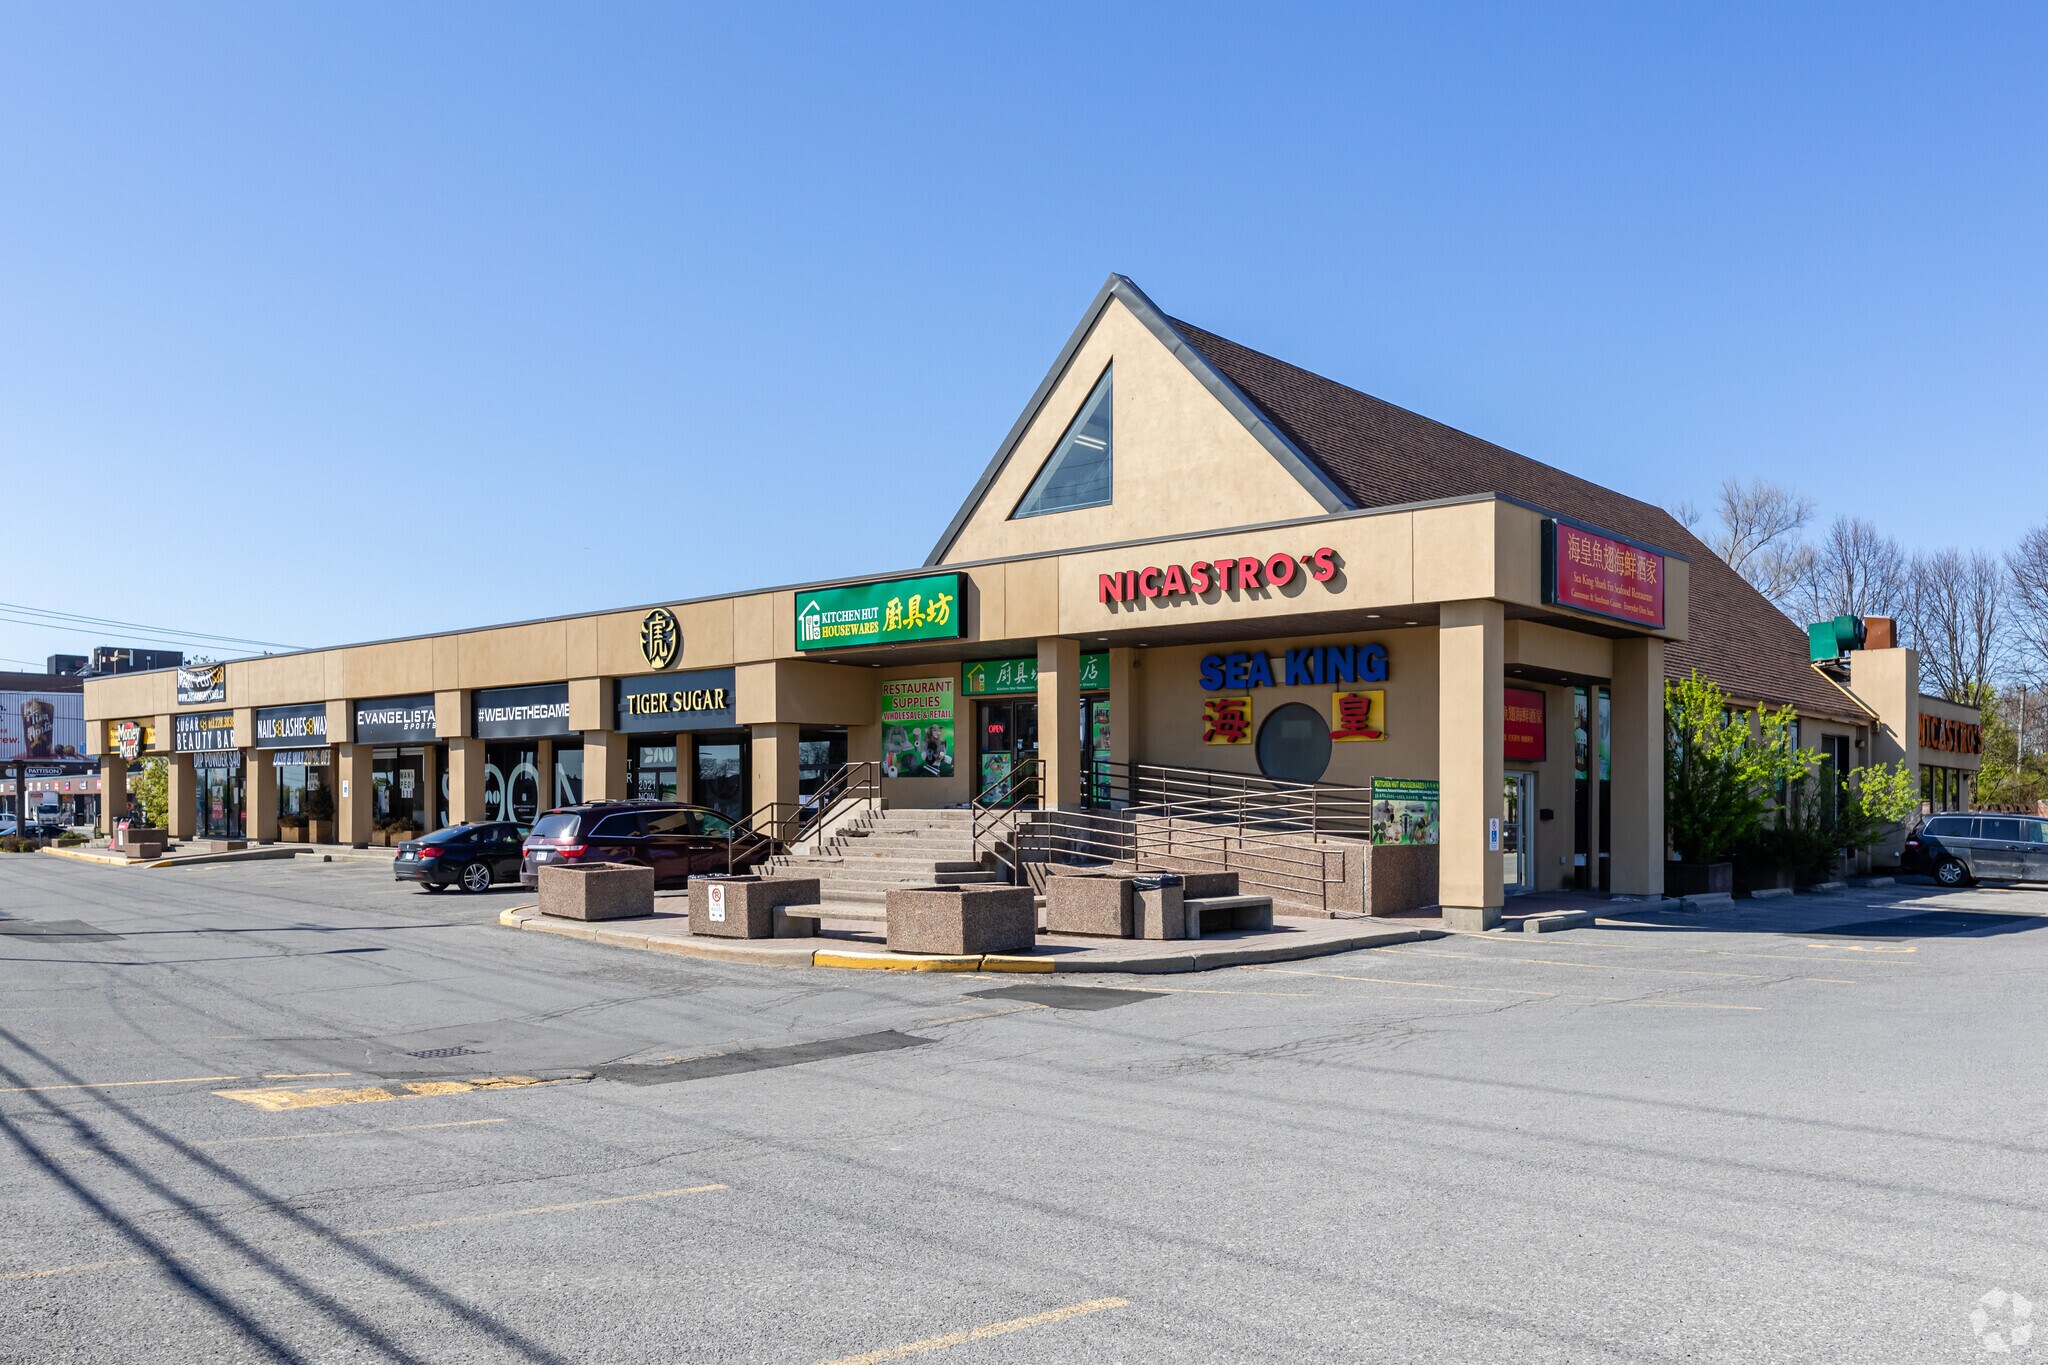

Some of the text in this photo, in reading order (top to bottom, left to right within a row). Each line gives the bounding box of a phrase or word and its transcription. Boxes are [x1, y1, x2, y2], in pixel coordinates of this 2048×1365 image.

[1568, 533, 1657, 585] 海皇魚翅海鮮酒家
[1573, 571, 1581, 584] Sea
[1582, 573, 1594, 590] King
[1594, 577, 1607, 590] Shark
[822, 606, 879, 624] KITCHEN HUT
[822, 621, 879, 638] HOUSEWARES
[1200, 643, 1390, 691] SEA KING
[883, 680, 952, 695] RESTAURANT
[626, 687, 727, 715] TIGER SUGAR
[893, 696, 940, 709] SUPPLIES
[357, 709, 436, 725] EVANGELISTA
[478, 703, 569, 722] #WELIVETHEGAME
[883, 710, 952, 721] WHOLESALE & RETAIL
[1202, 699, 1250, 743] 海
[1330, 693, 1383, 740] 皇
[177, 716, 199, 732] SUGAR
[257, 719, 276, 739] NAILS
[281, 717, 307, 738] LASHES
[404, 721, 437, 730] SPORTS
[988, 724, 1004, 733] OPEN
[117, 724, 141, 746] Money
[177, 729, 235, 751] BEAUTY BAR
[119, 741, 139, 759] Mart
[273, 752, 287, 765] LASH
[292, 751, 304, 765] WAX
[304, 750, 319, 765] 20%
[320, 749, 331, 765] OFF
[193, 753, 203, 768] DIP
[204, 752, 228, 768] POWDER
[638, 780, 656, 790] 2021
